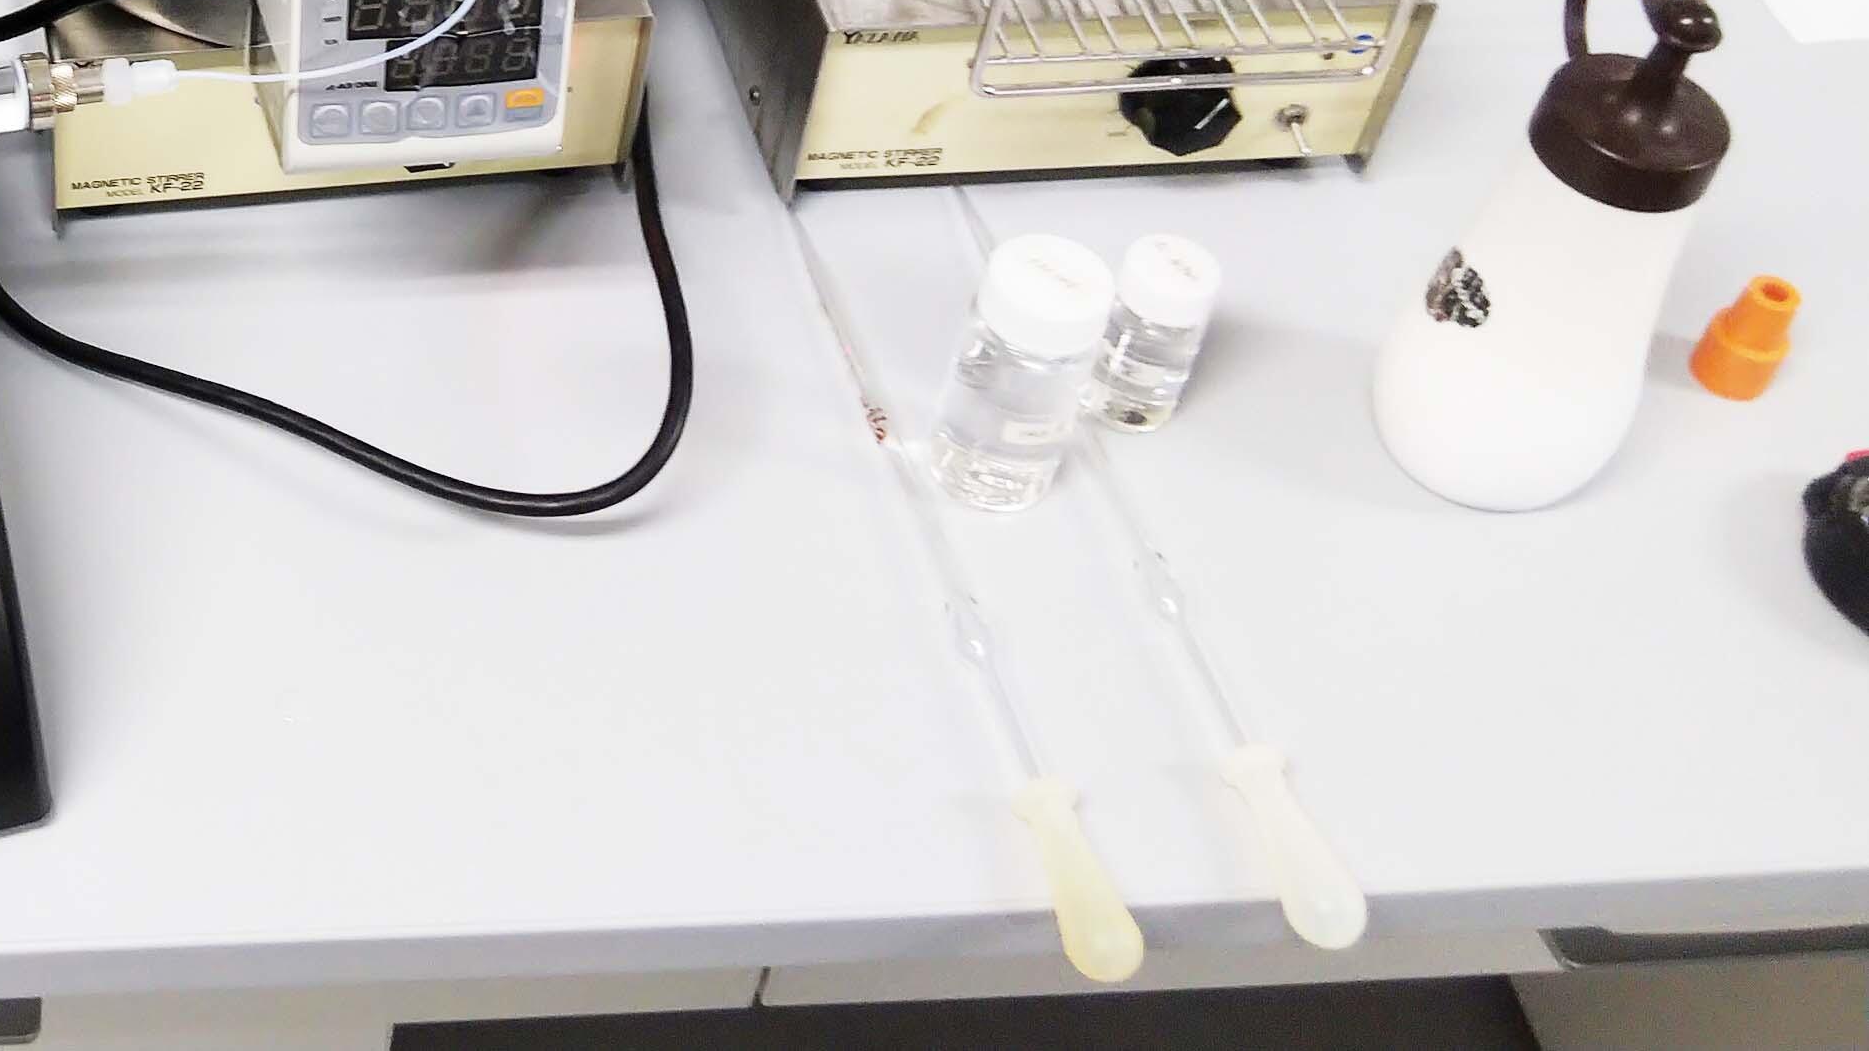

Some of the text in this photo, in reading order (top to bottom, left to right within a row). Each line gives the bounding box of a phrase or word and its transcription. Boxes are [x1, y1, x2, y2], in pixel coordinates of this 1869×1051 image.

[71, 172, 205, 190] MAGNETIC STIRRER
[149, 180, 205, 194] KF-22
